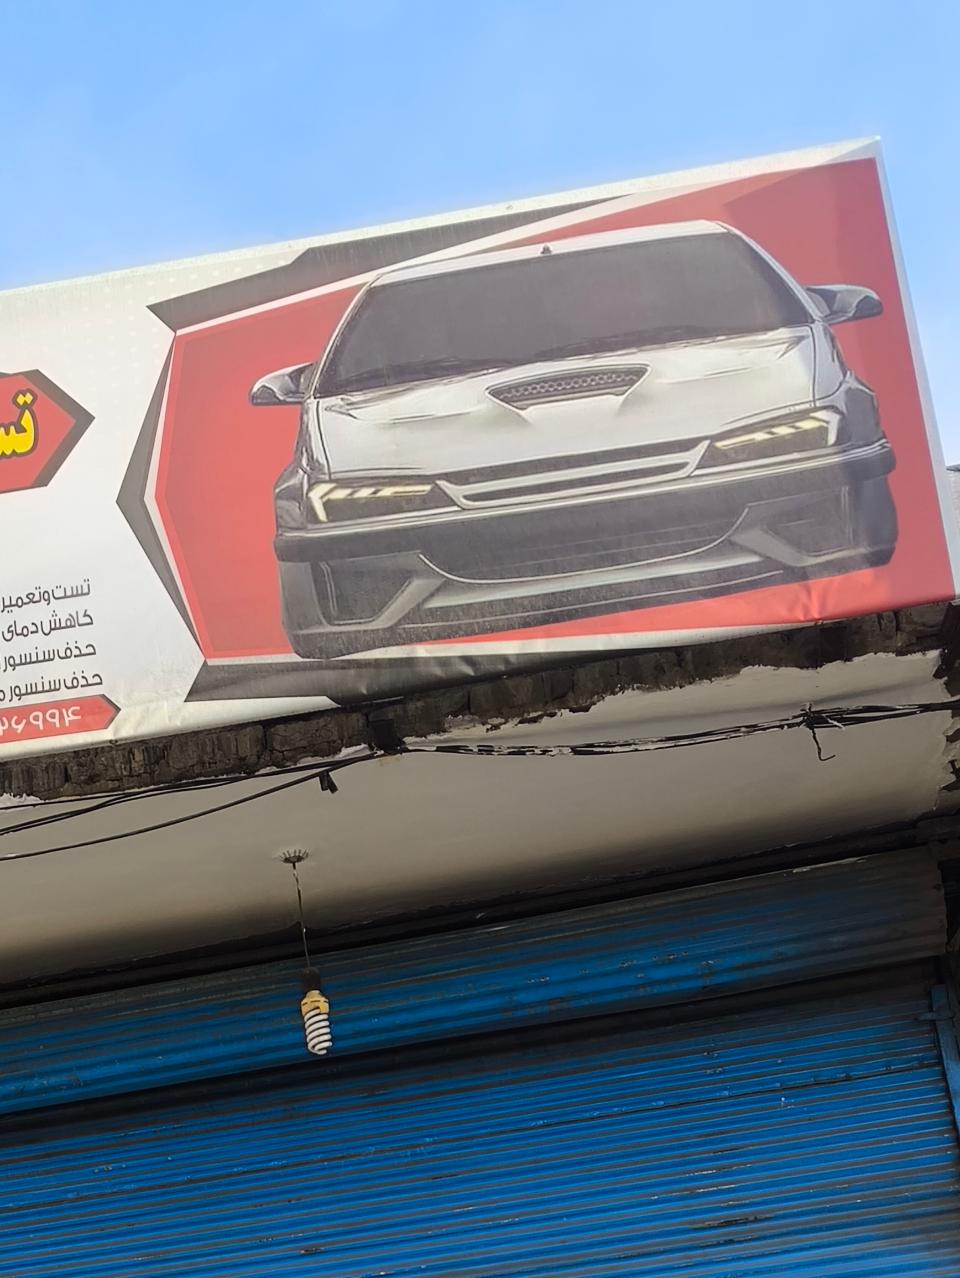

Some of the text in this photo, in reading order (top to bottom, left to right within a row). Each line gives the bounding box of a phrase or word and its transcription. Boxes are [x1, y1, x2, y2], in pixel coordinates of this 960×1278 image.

[51, 578, 91, 600] تست
[1, 620, 39, 642] دمای
[41, 609, 94, 636] کاهش
[3, 646, 56, 672] سنسور
[56, 641, 97, 660] حذف
[8, 677, 62, 702] سنسور
[63, 671, 103, 690] حذف
